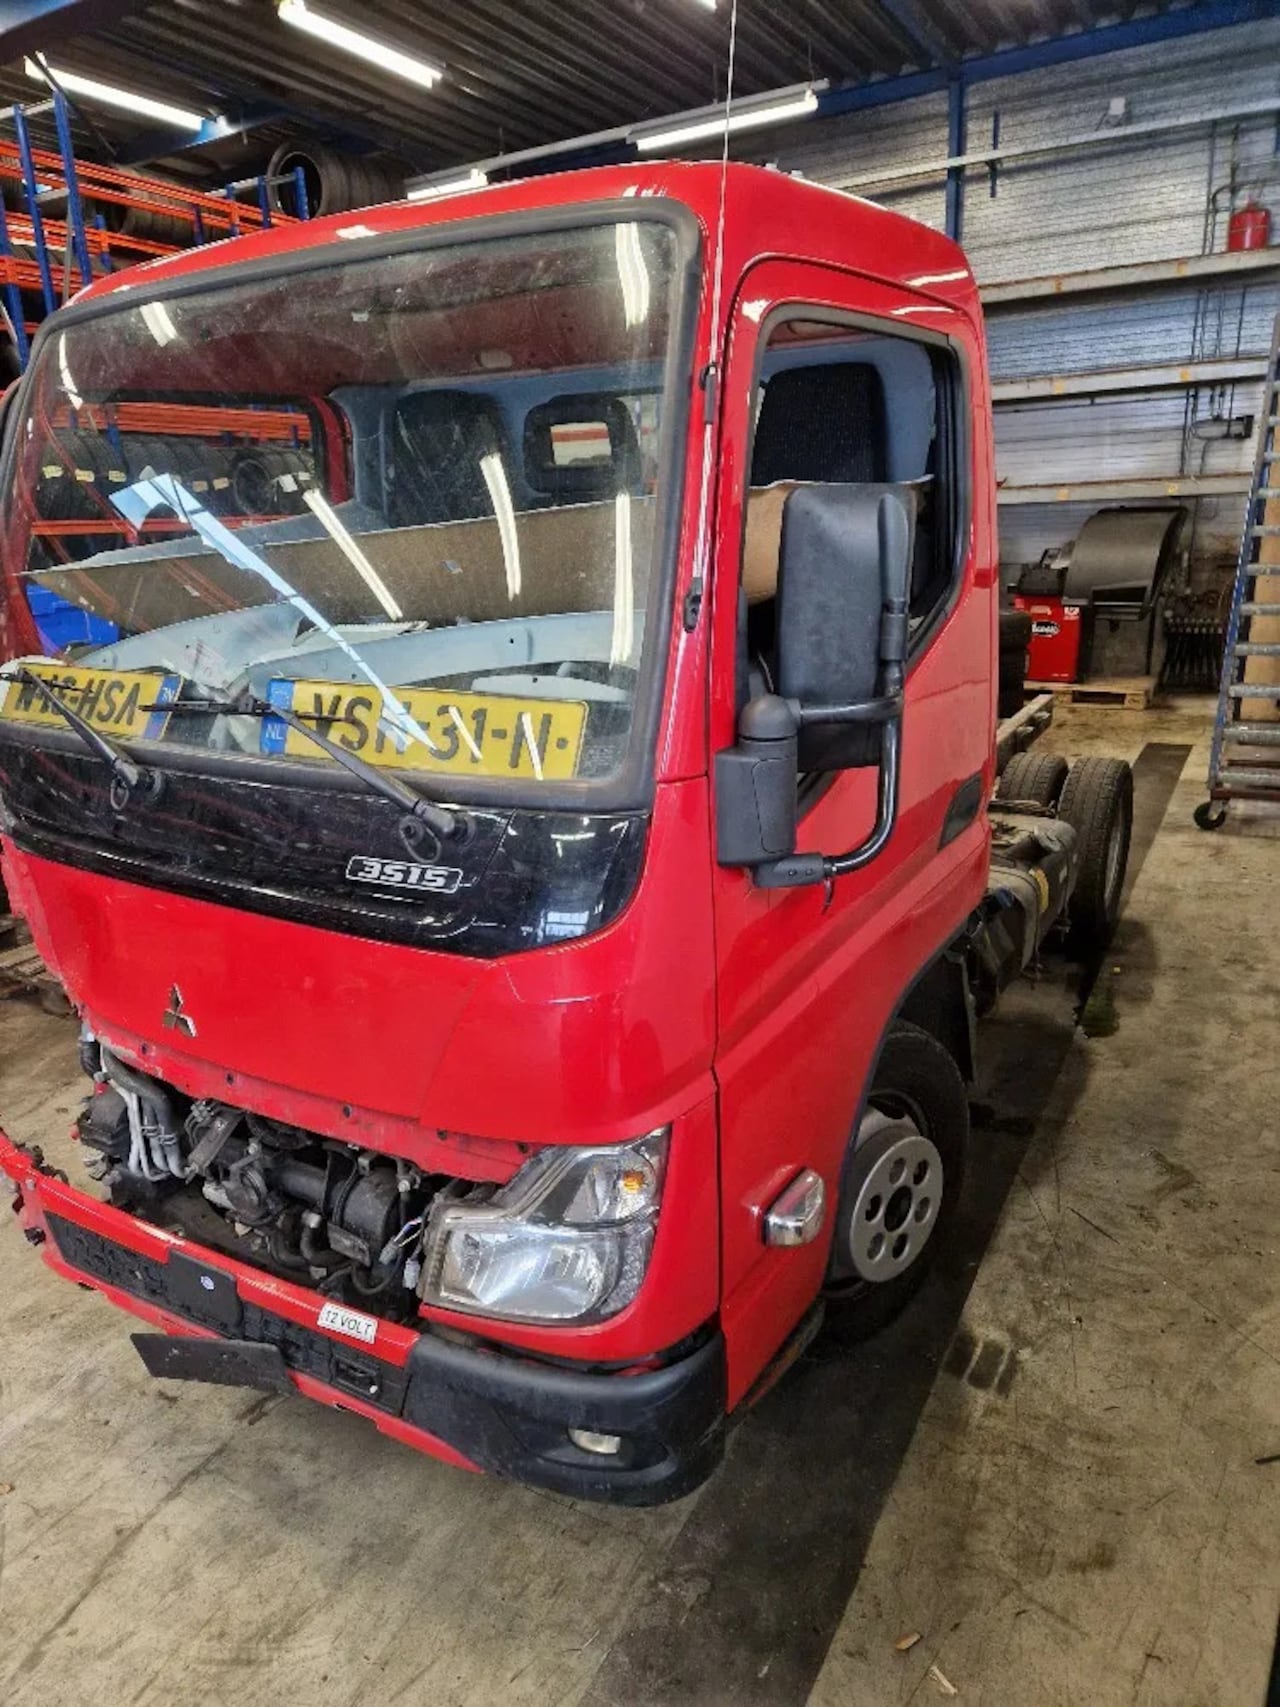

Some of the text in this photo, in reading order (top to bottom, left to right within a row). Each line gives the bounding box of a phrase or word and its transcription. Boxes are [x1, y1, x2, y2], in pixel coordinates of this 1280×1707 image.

[265, 723, 284, 741] NL
[325, 1310, 373, 1335] 12 VOLT
